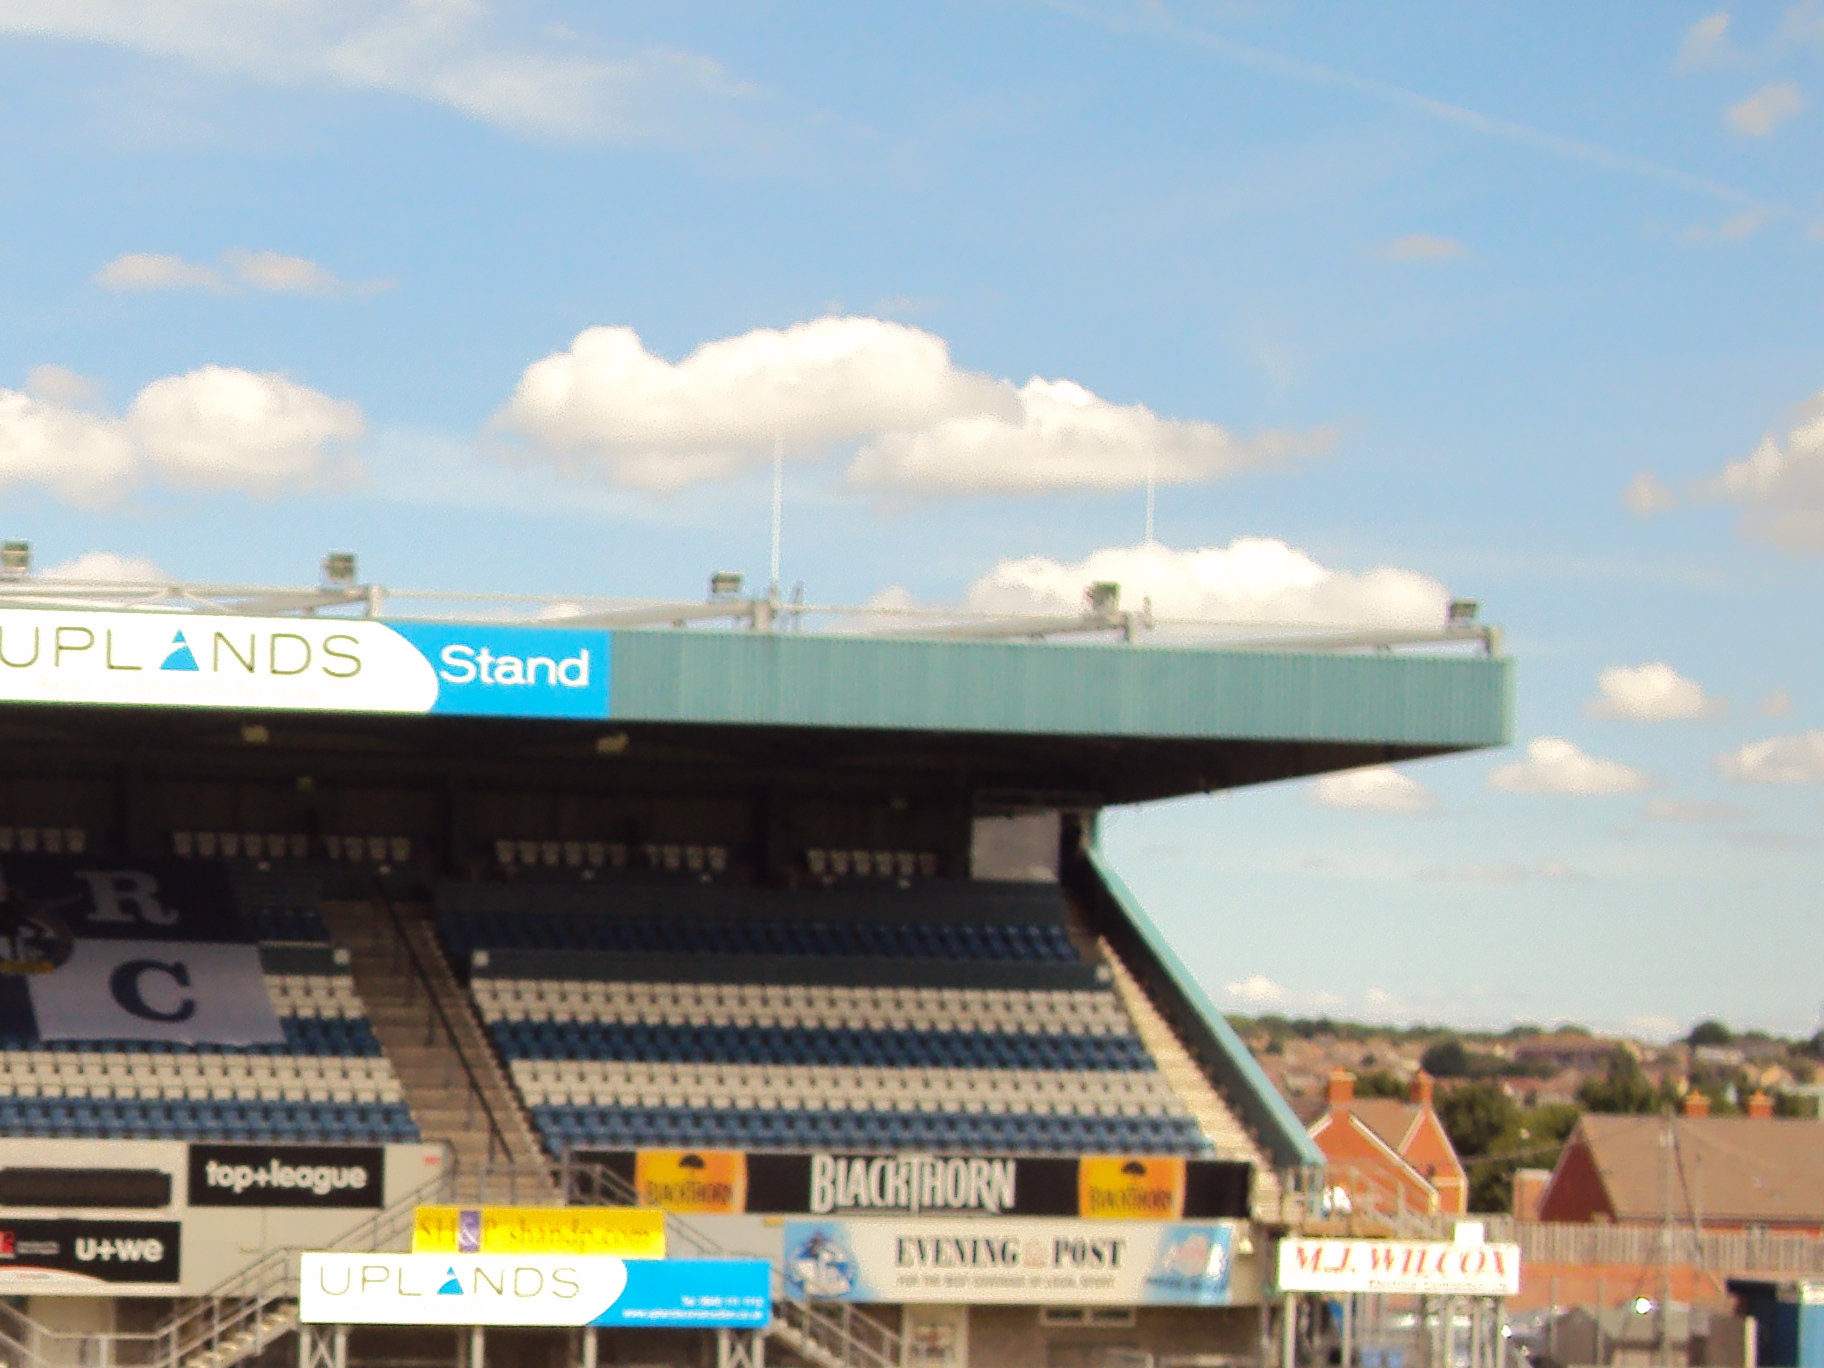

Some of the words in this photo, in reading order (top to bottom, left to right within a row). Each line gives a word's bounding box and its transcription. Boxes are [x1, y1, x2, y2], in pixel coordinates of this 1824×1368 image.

[440, 644, 590, 687] Stand
[76, 869, 180, 926] R
[109, 959, 197, 1023] C
[205, 1158, 369, 1195] top+league
[809, 1153, 1017, 1217] BLACKTHORN
[75, 1238, 164, 1262] u+we
[895, 1236, 1020, 1268] EVENING
[1052, 1237, 1126, 1269] POST
[1369, 1247, 1507, 1277] WILCOX
[319, 1264, 581, 1299] UPLANDS
